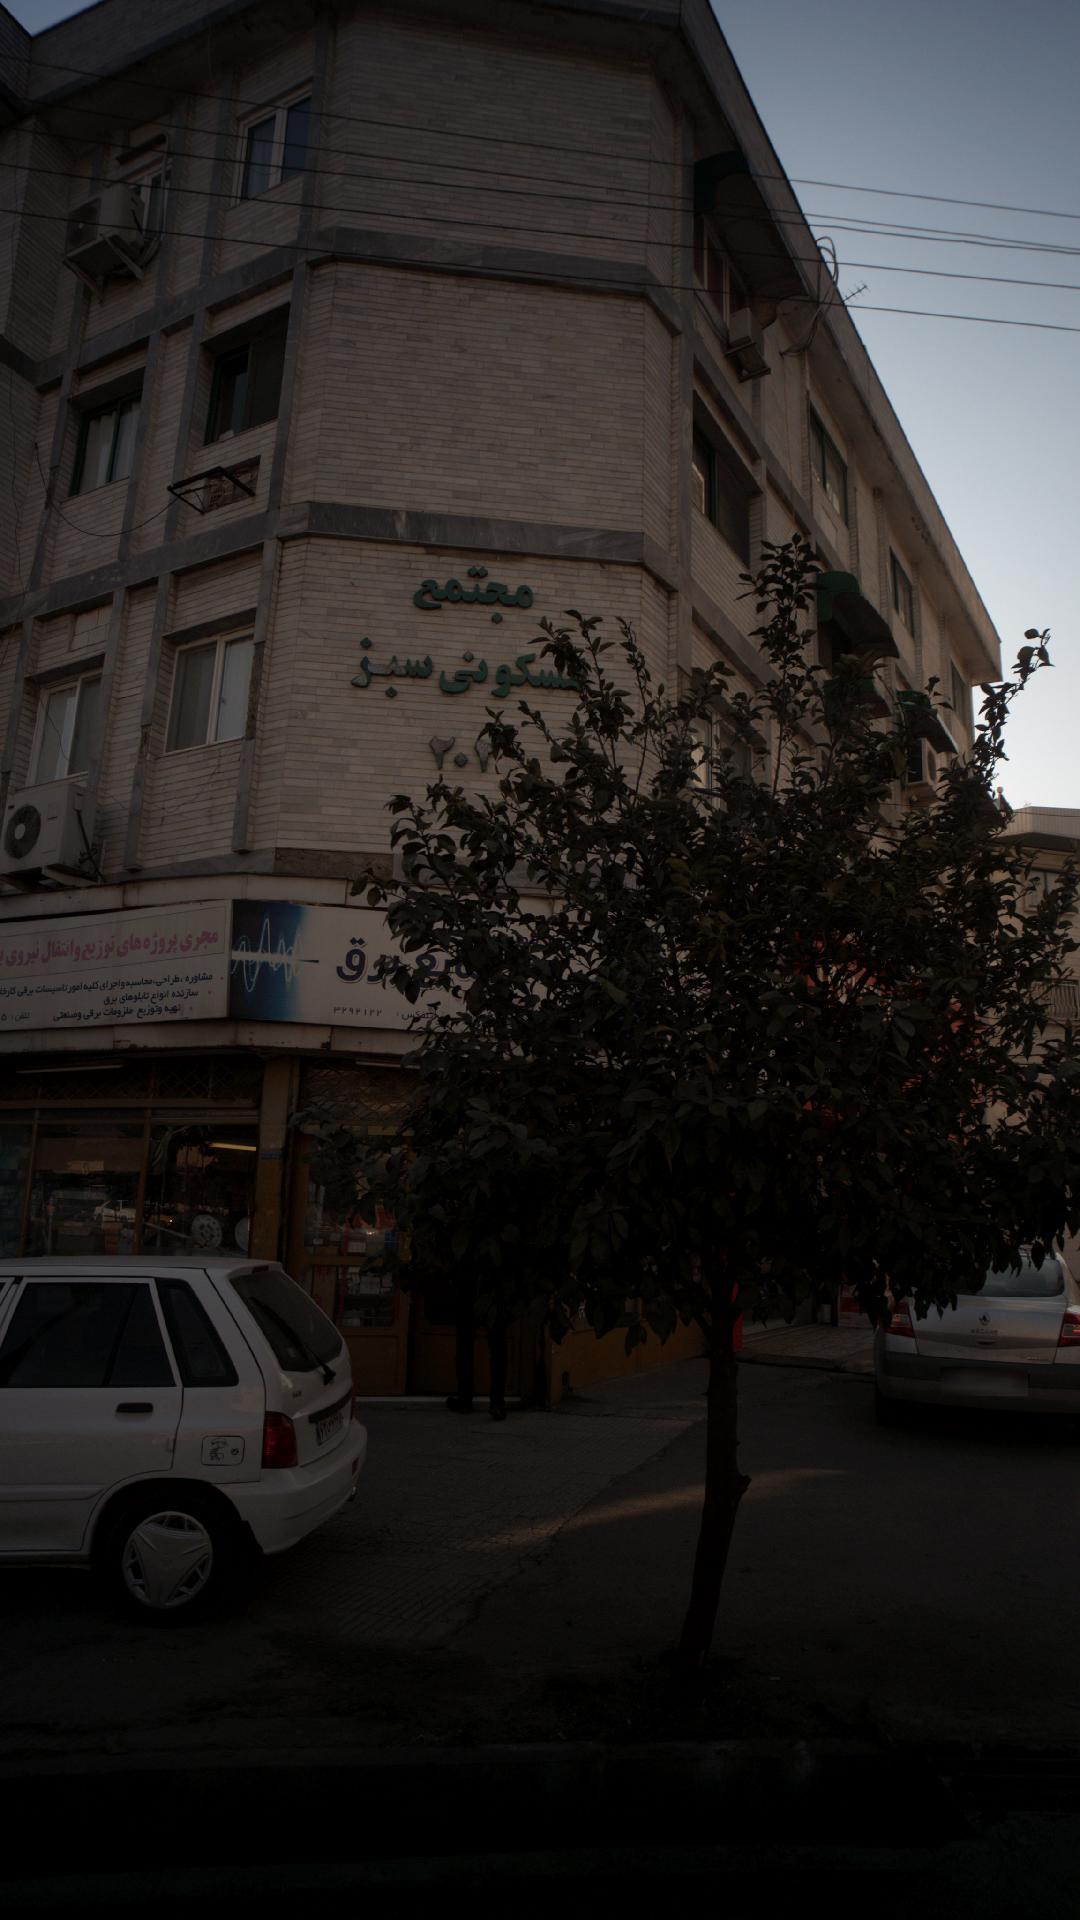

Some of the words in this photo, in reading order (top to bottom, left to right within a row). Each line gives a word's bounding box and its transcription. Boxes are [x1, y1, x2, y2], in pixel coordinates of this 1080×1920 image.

[413, 566, 534, 624] مجتمع
[351, 637, 433, 698] سبز
[6, 940, 39, 967] نیروی
[82, 936, 114, 961] توزیع
[180, 930, 218, 952] مجری
[103, 996, 117, 1006] برق
